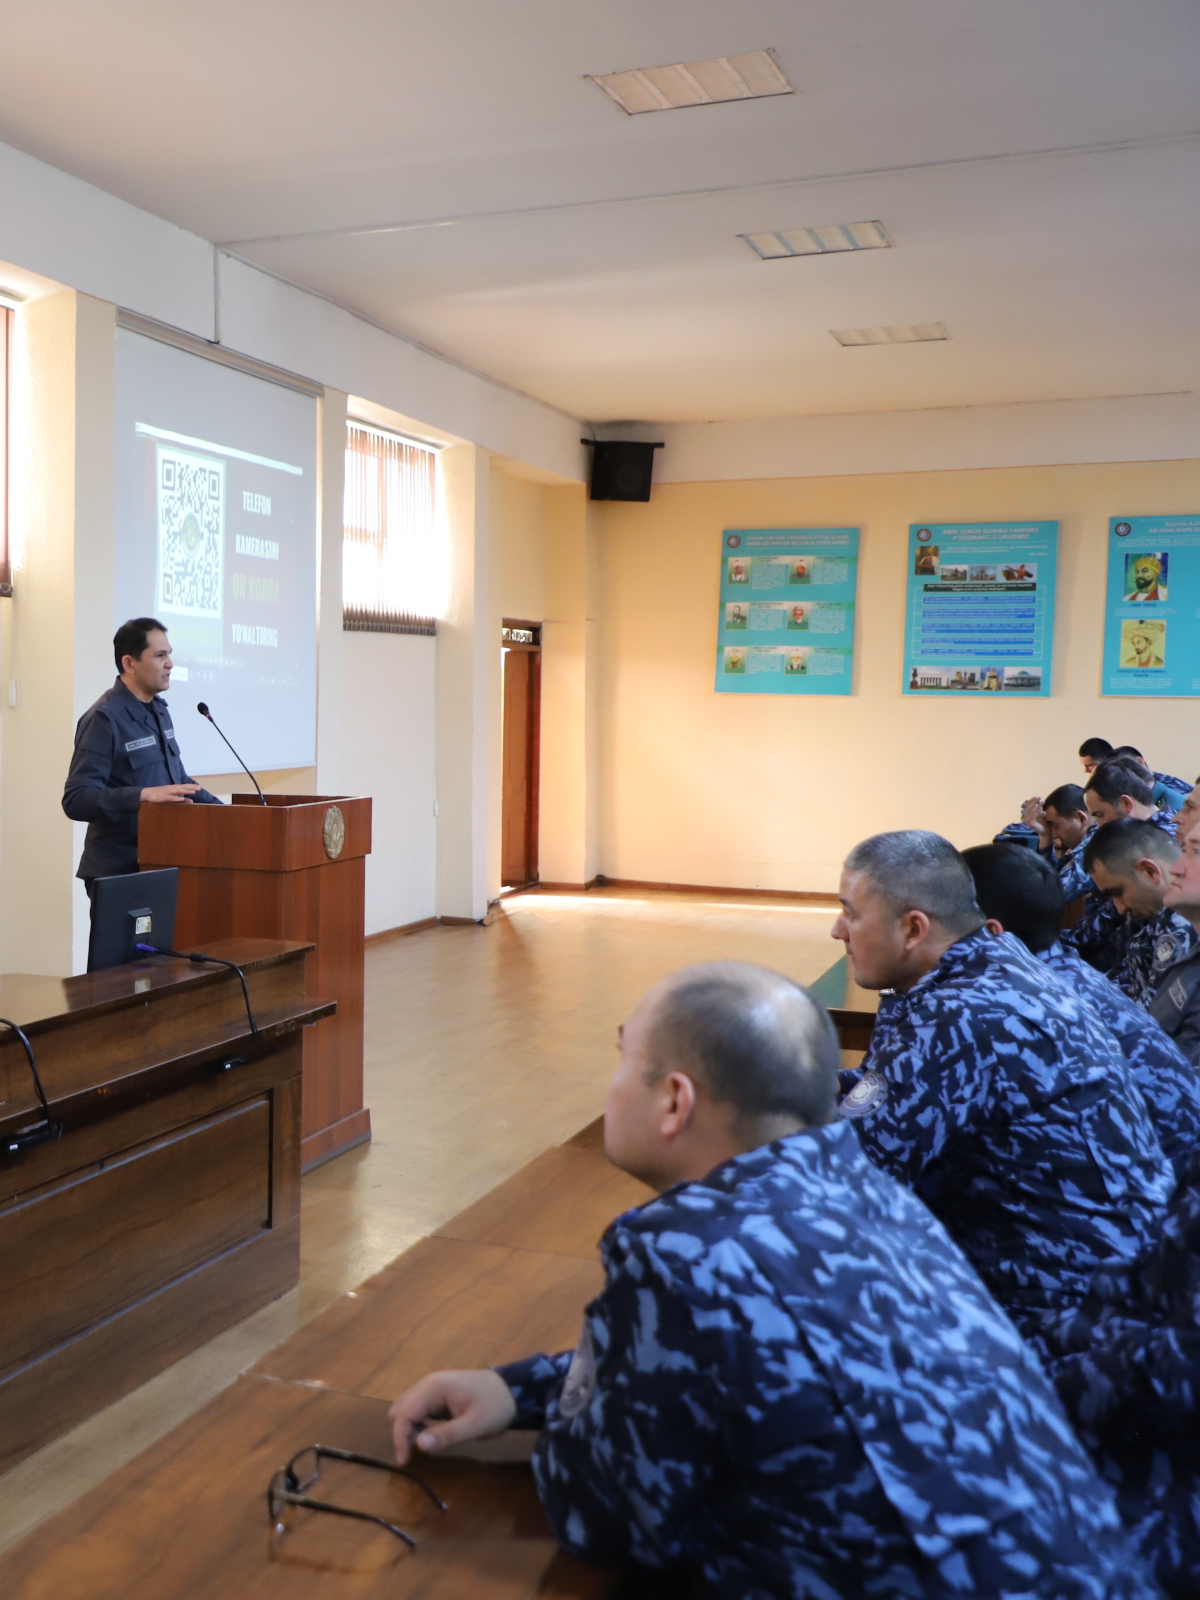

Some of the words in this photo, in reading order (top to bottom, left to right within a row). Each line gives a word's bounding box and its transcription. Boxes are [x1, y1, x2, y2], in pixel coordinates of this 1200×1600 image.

[242, 490, 272, 516] TELEFON
[235, 533, 280, 561] KAMERASINI
[232, 572, 246, 601] QR
[248, 575, 280, 604] KODGA
[231, 622, 279, 648] YO'NALTIRING
